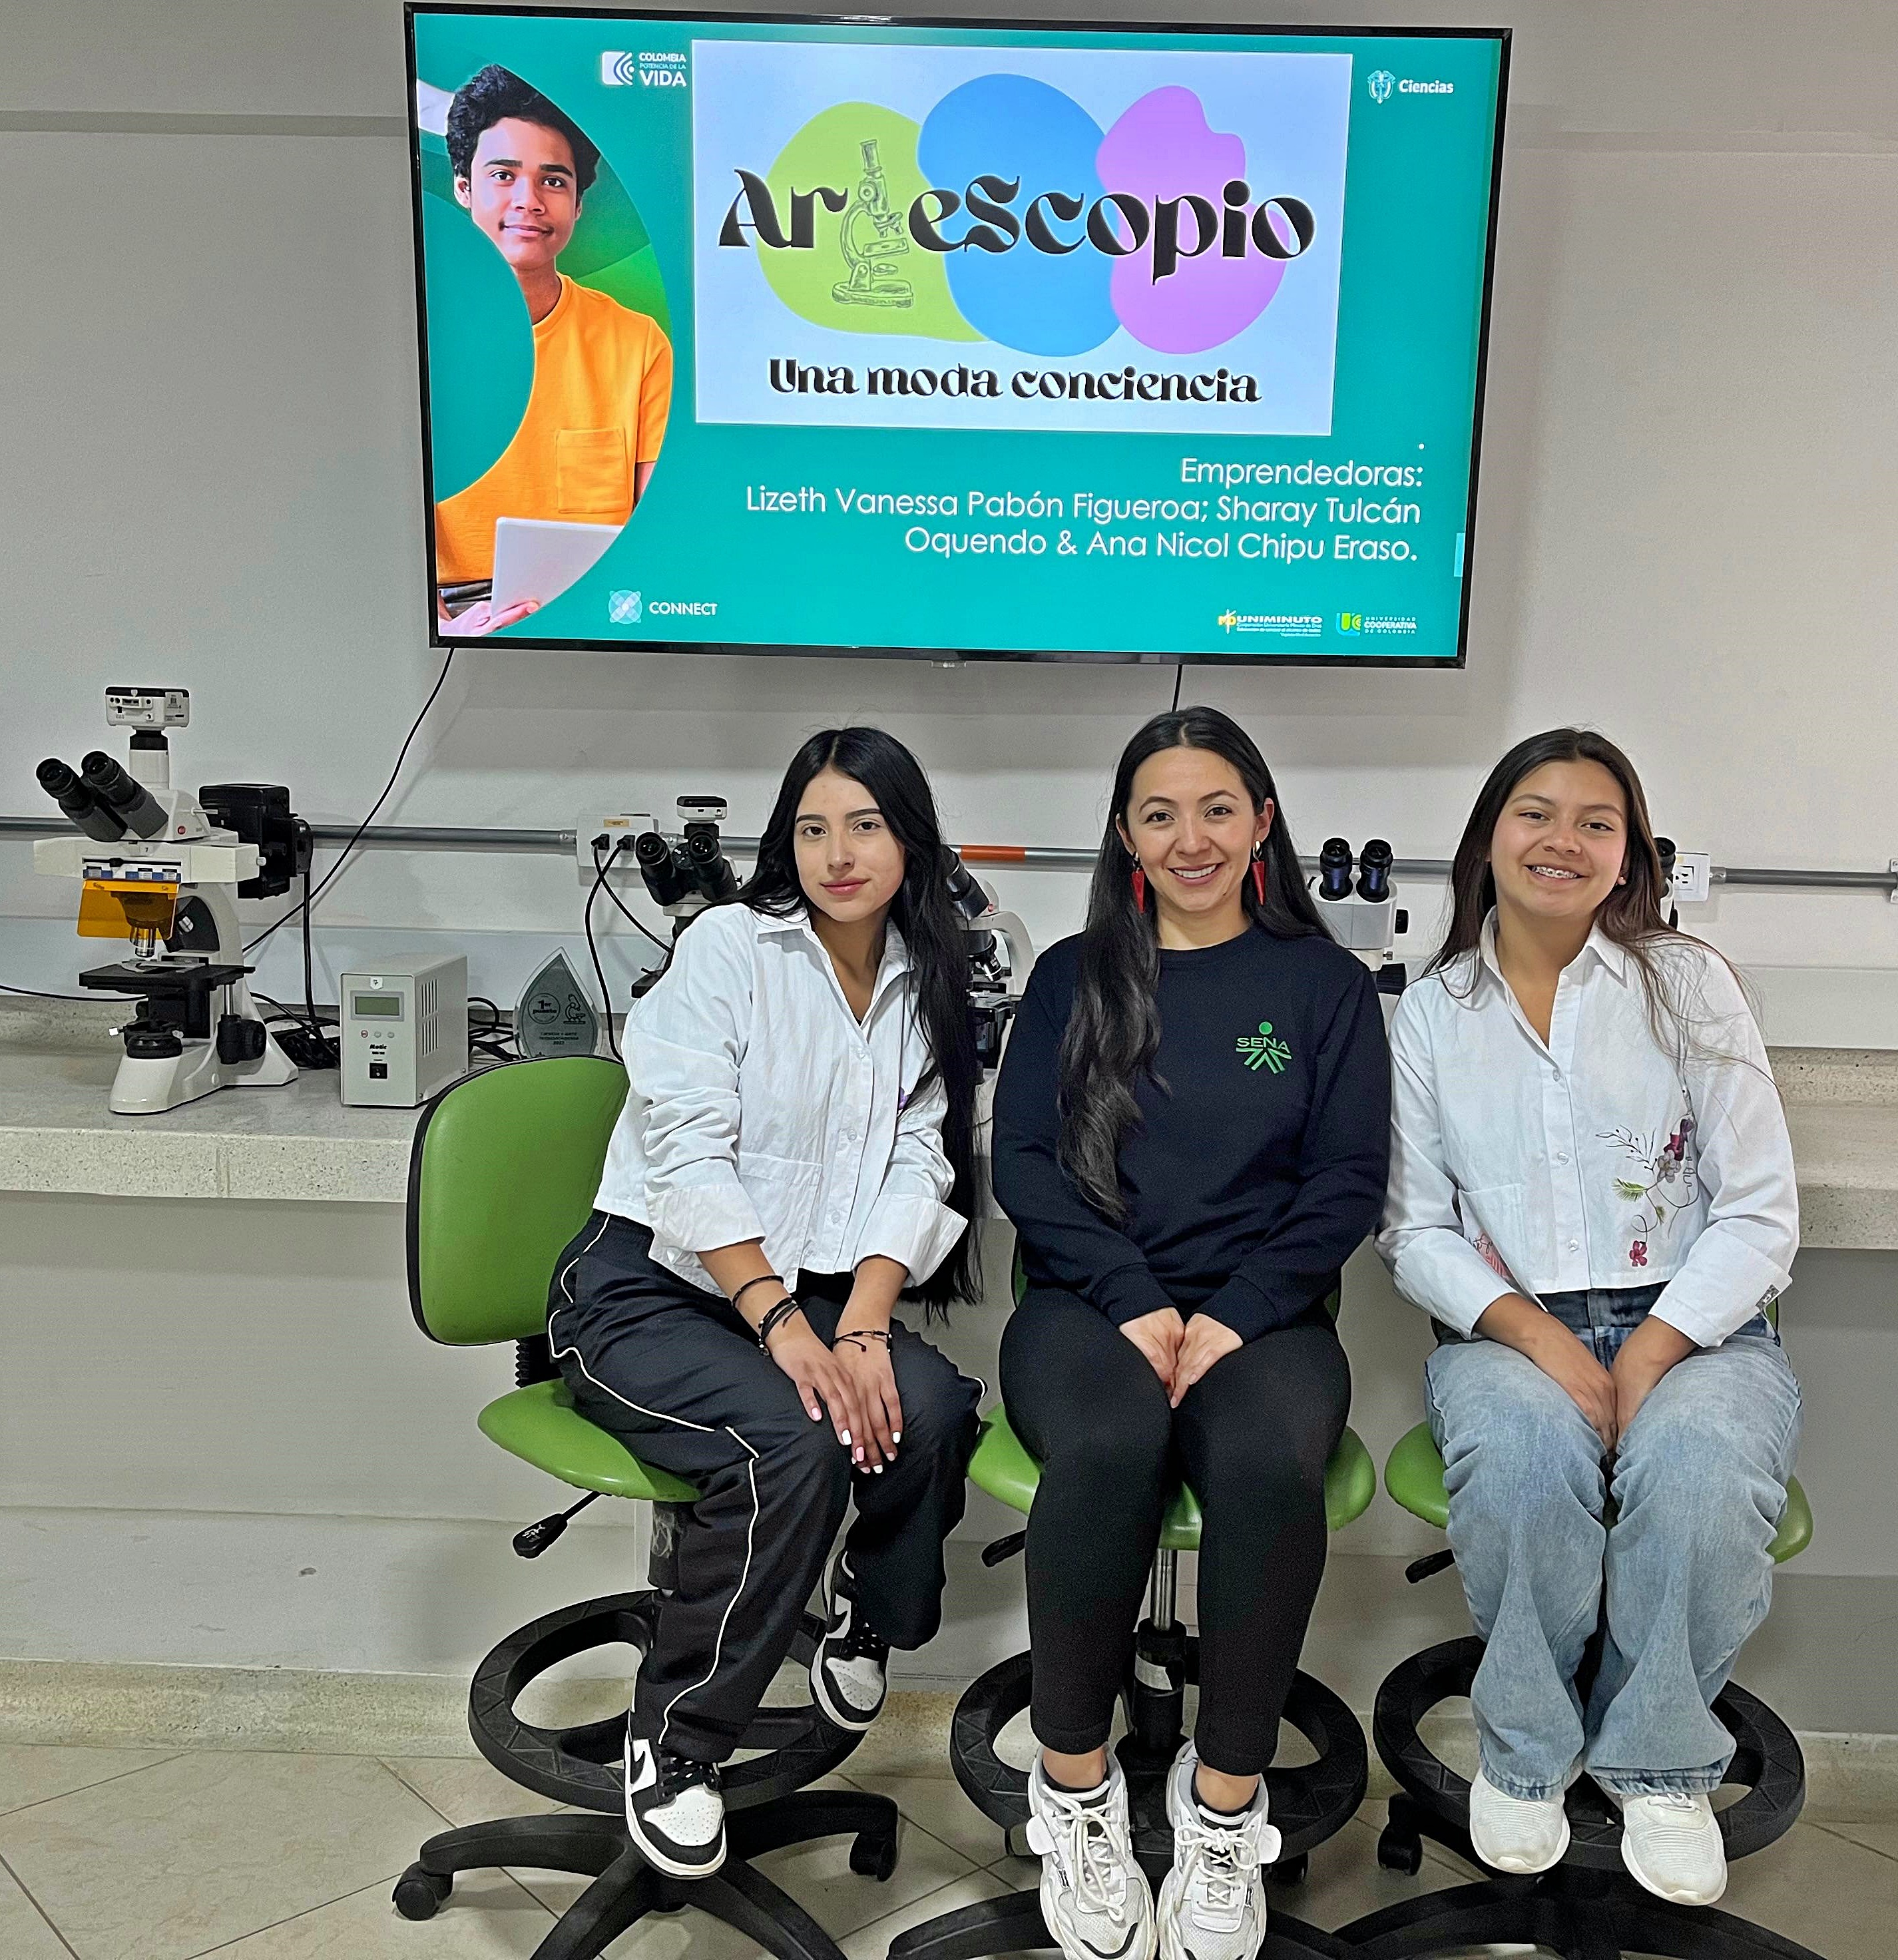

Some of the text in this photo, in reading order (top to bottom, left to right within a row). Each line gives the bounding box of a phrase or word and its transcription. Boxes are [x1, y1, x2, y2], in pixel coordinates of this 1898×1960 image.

[639, 53, 686, 63] COLOMBIA
[639, 69, 687, 87] VIDA
[1399, 79, 1454, 94] Ciencias
[770, 358, 1263, 402] Una moda conciencia
[1181, 457, 1423, 489] Emprendedoras:
[746, 485, 1421, 528] Lizeth Vanessa Pabón Figueroa; Sharay Tulcán
[905, 526, 1418, 565] Oquendo & Ana Nicol Chipu Eraso.
[648, 601, 718, 616] CONNECT
[1236, 615, 1323, 624] UNIMINUTO
[1237, 1037, 1290, 1053] SENA
